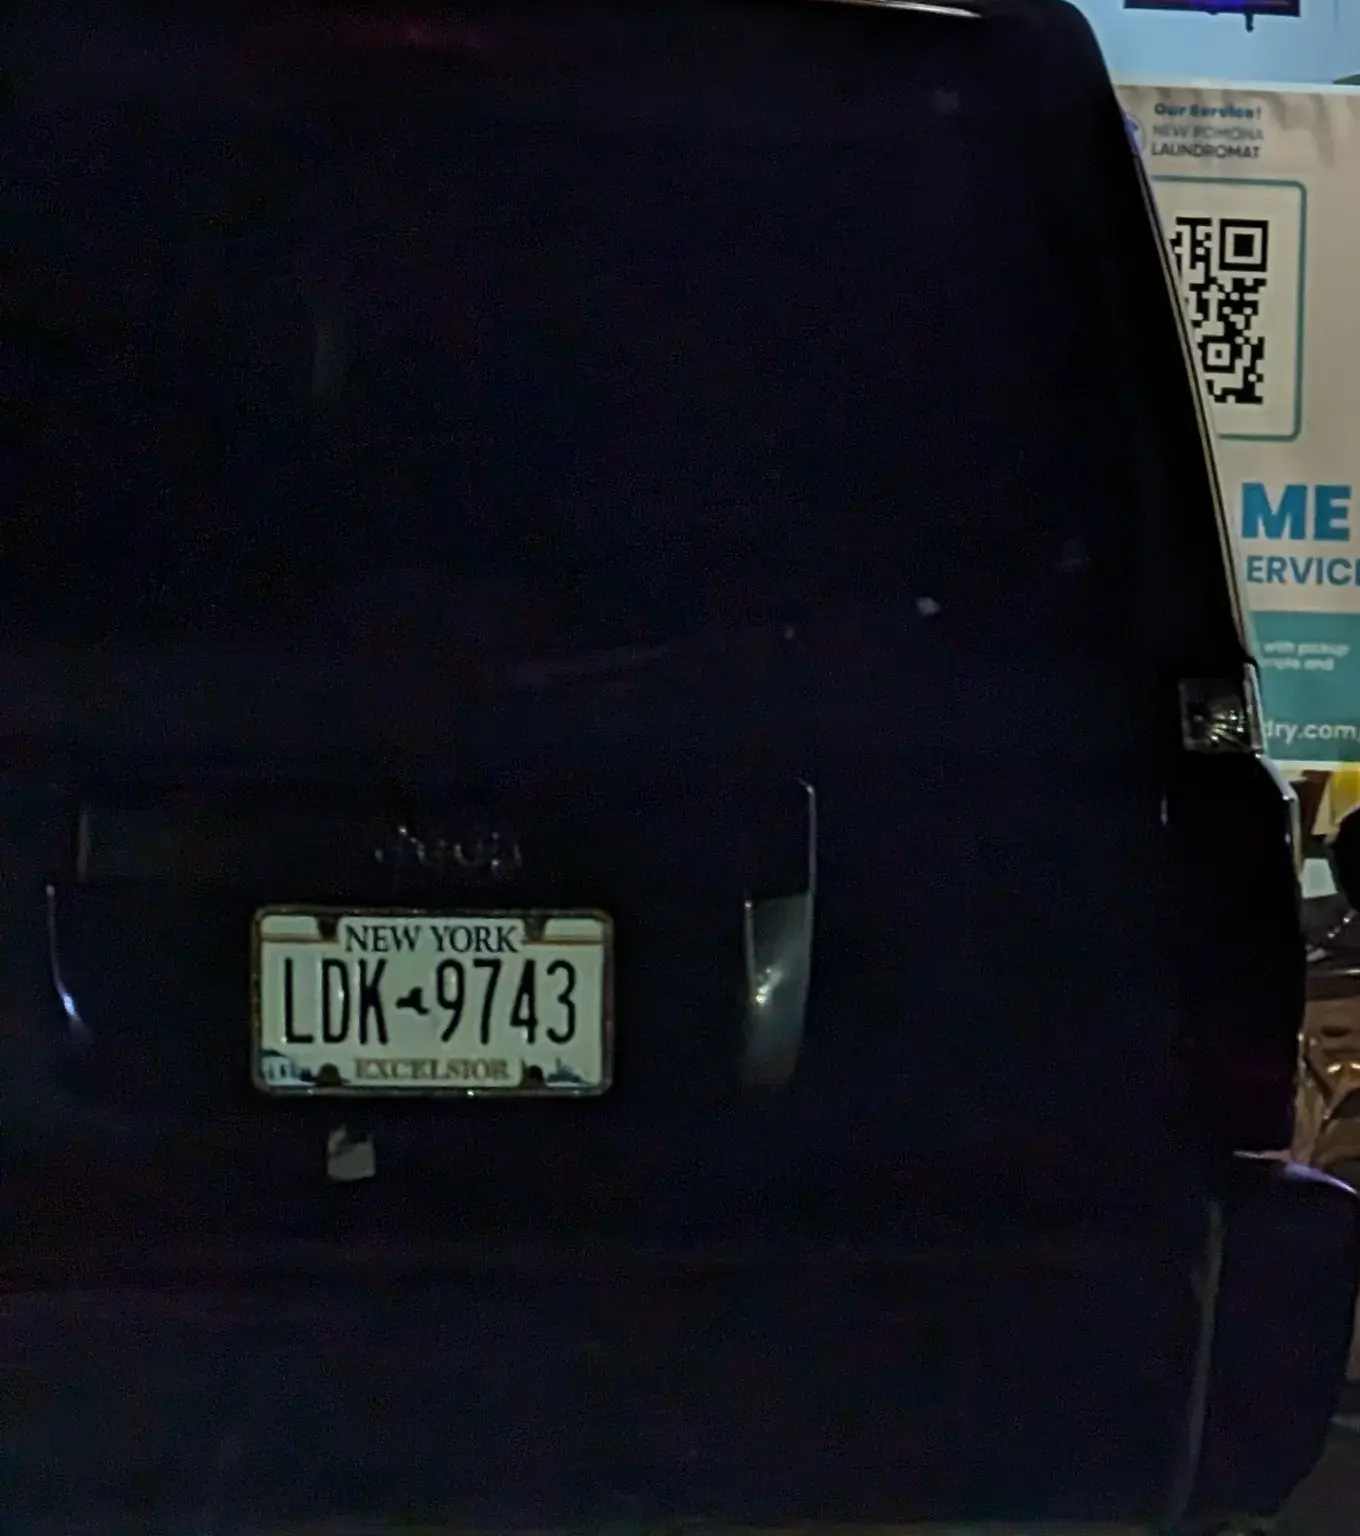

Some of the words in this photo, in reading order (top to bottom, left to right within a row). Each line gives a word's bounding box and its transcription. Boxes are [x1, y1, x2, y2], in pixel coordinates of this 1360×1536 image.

[1151, 142, 1262, 159] LAUNDROMAT
[1241, 482, 1352, 542] ME
[345, 924, 421, 953] NEW
[430, 925, 521, 954] YORK
[284, 957, 389, 1045] LDK
[436, 959, 576, 1045] 9743
[354, 1058, 511, 1081] EXCELSIOR
